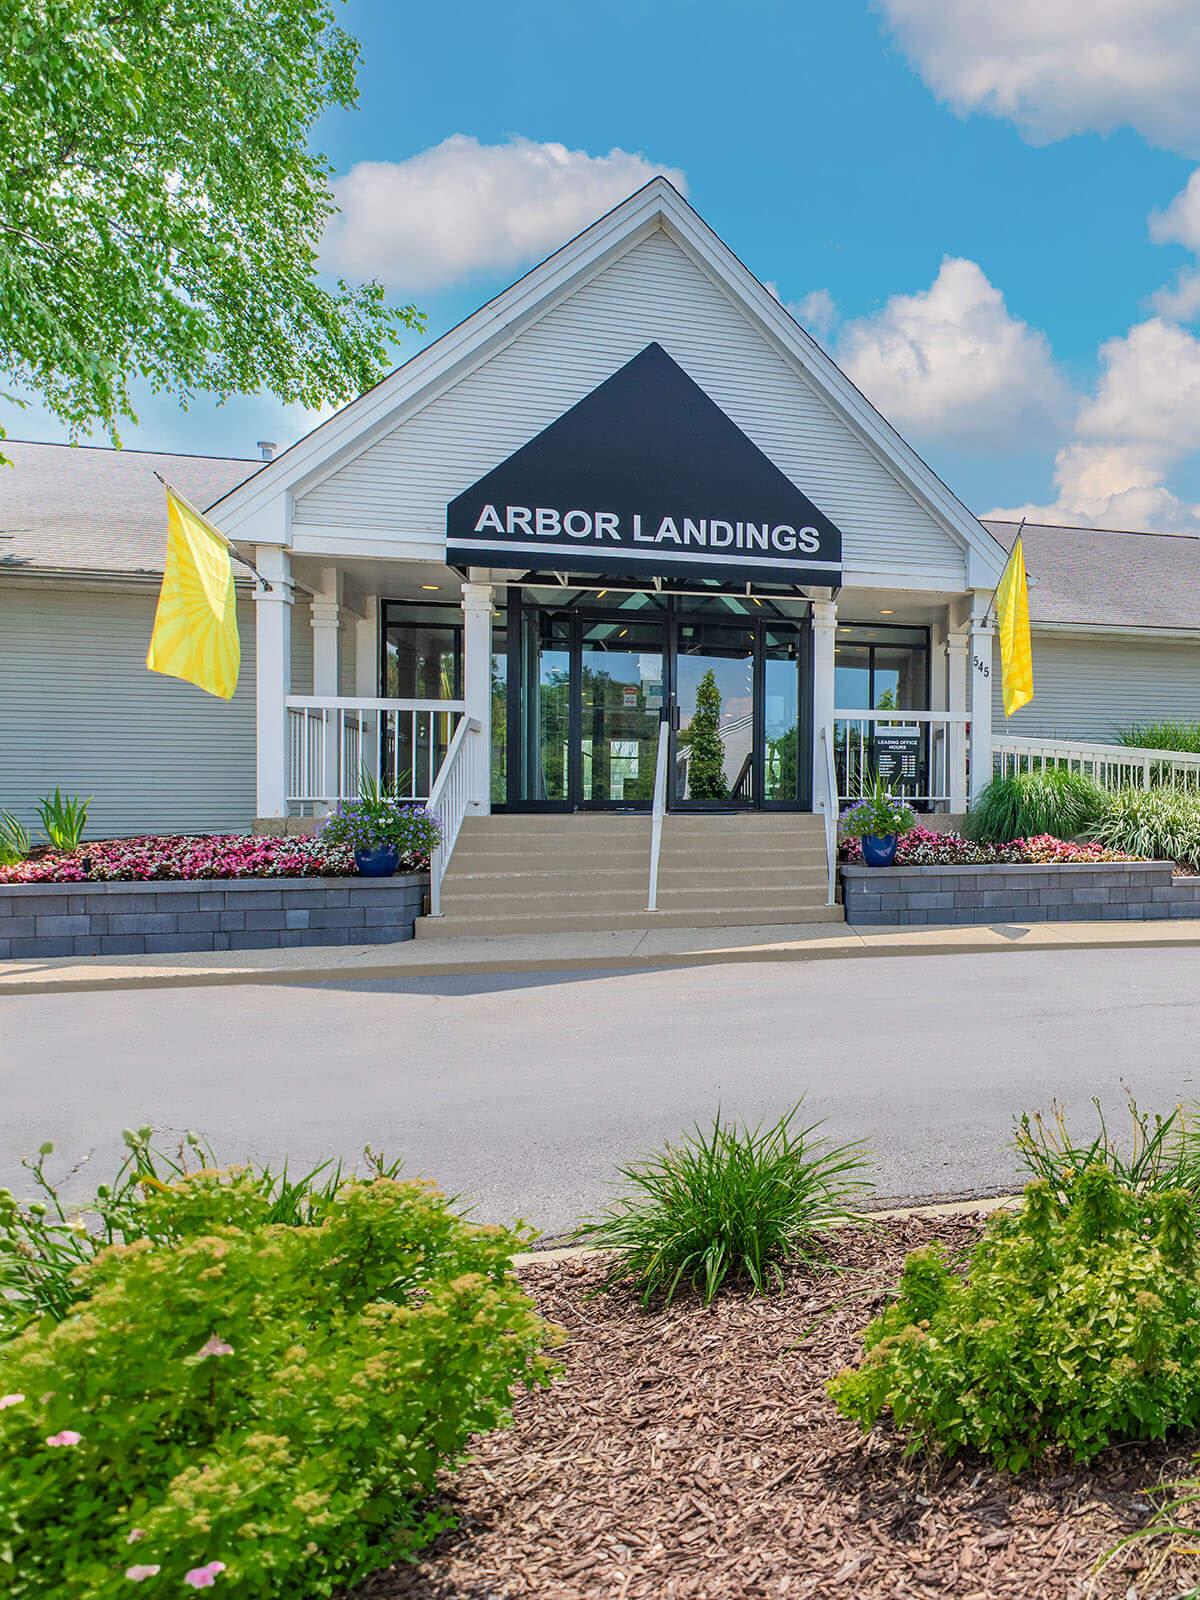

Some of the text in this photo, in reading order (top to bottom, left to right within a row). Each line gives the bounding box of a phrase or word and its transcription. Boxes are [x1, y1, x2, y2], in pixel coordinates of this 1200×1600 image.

[474, 504, 820, 553] ARBOR LANDINGS
[973, 655, 989, 677] 545
